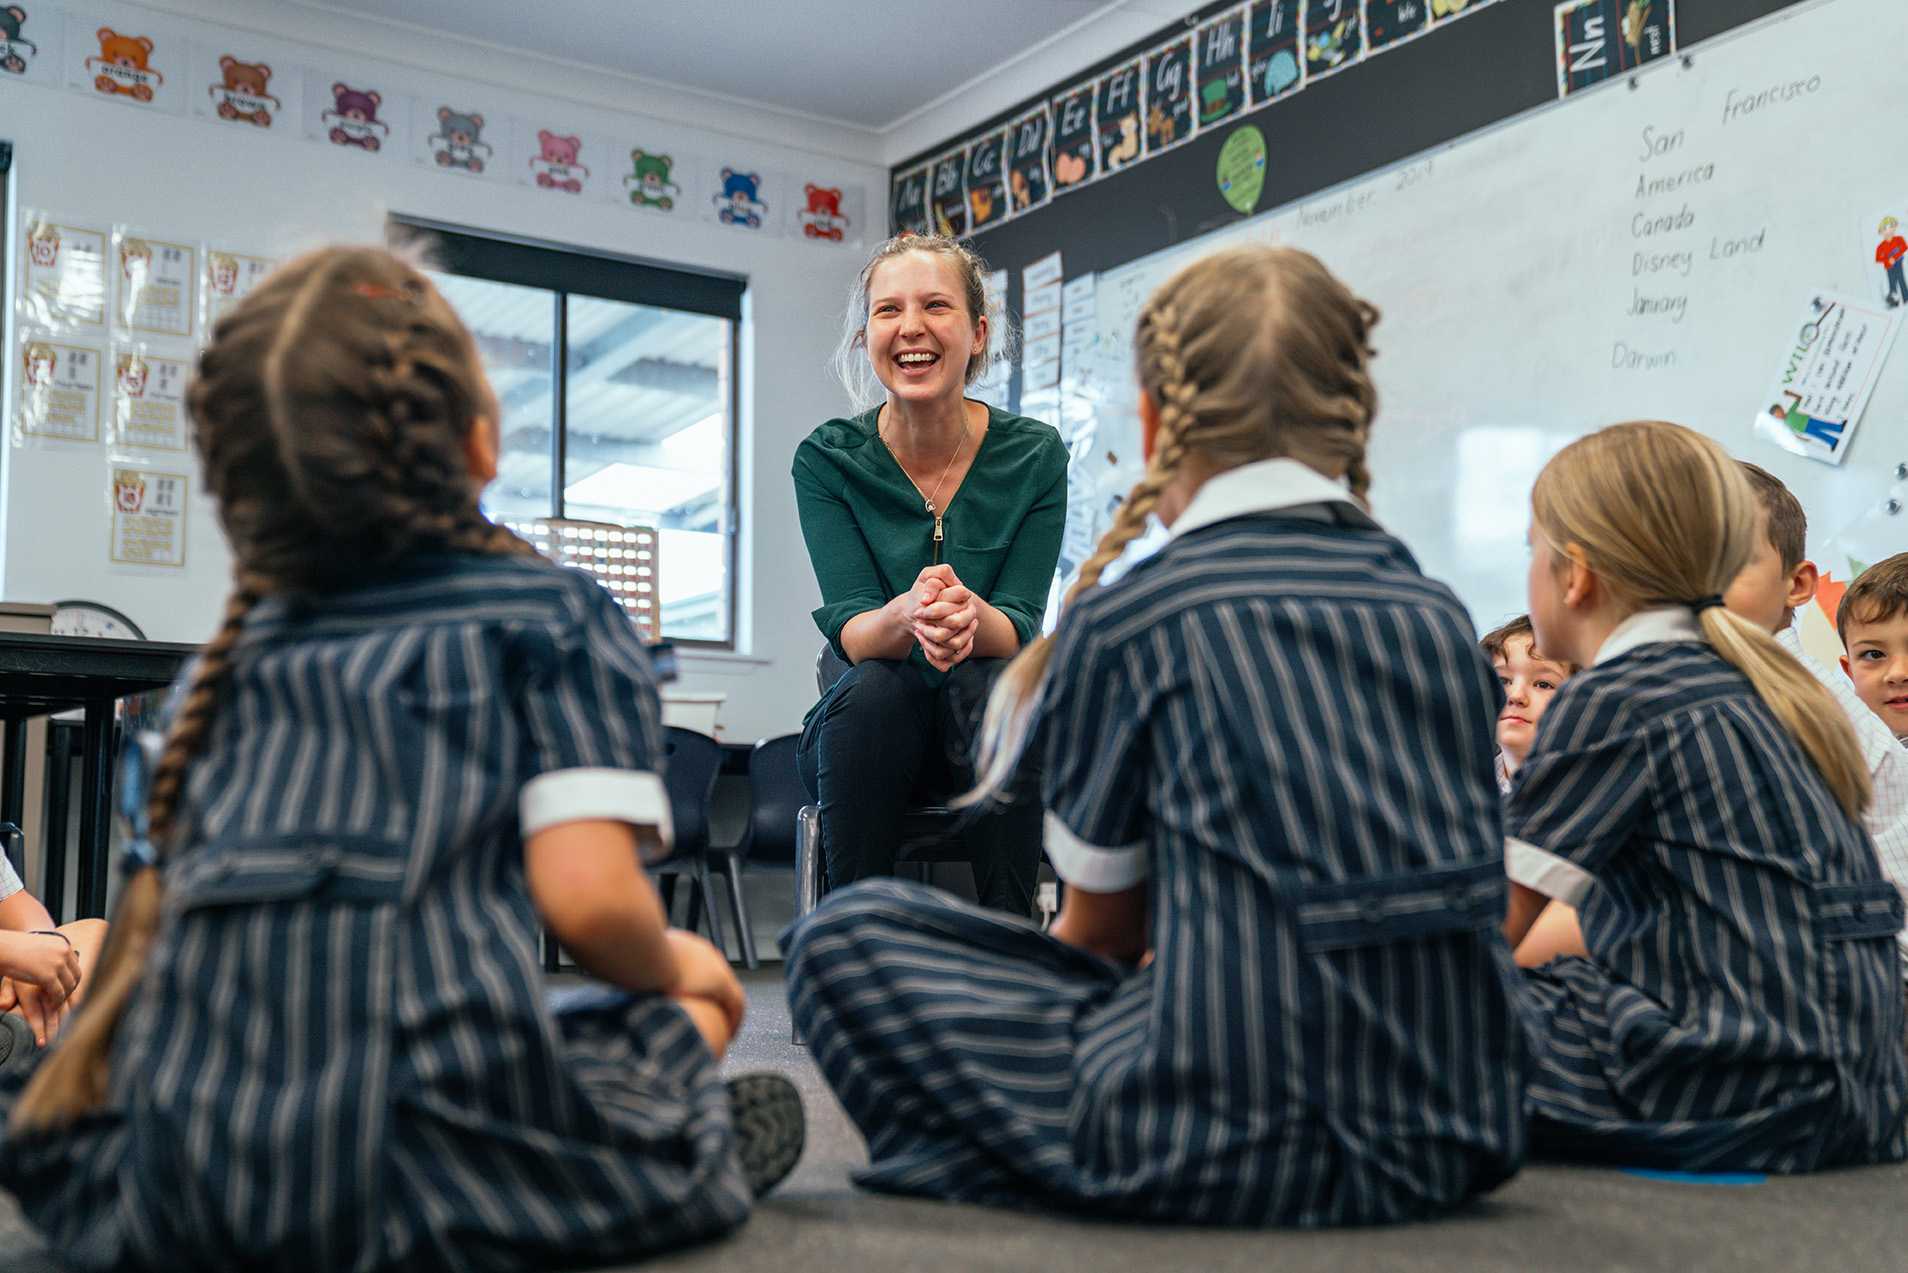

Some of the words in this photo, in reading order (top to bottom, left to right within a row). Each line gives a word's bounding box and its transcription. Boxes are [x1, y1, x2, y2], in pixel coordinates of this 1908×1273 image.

[1205, 22, 1235, 67] Hh
[1568, 15, 1608, 73] Nn
[101, 65, 147, 84] orange
[1639, 124, 1685, 163] San
[1634, 162, 1715, 199] America
[1631, 203, 1695, 238] Canada
[1631, 249, 1692, 277] Disney
[1710, 228, 1766, 262] Land
[1627, 287, 1689, 323] January
